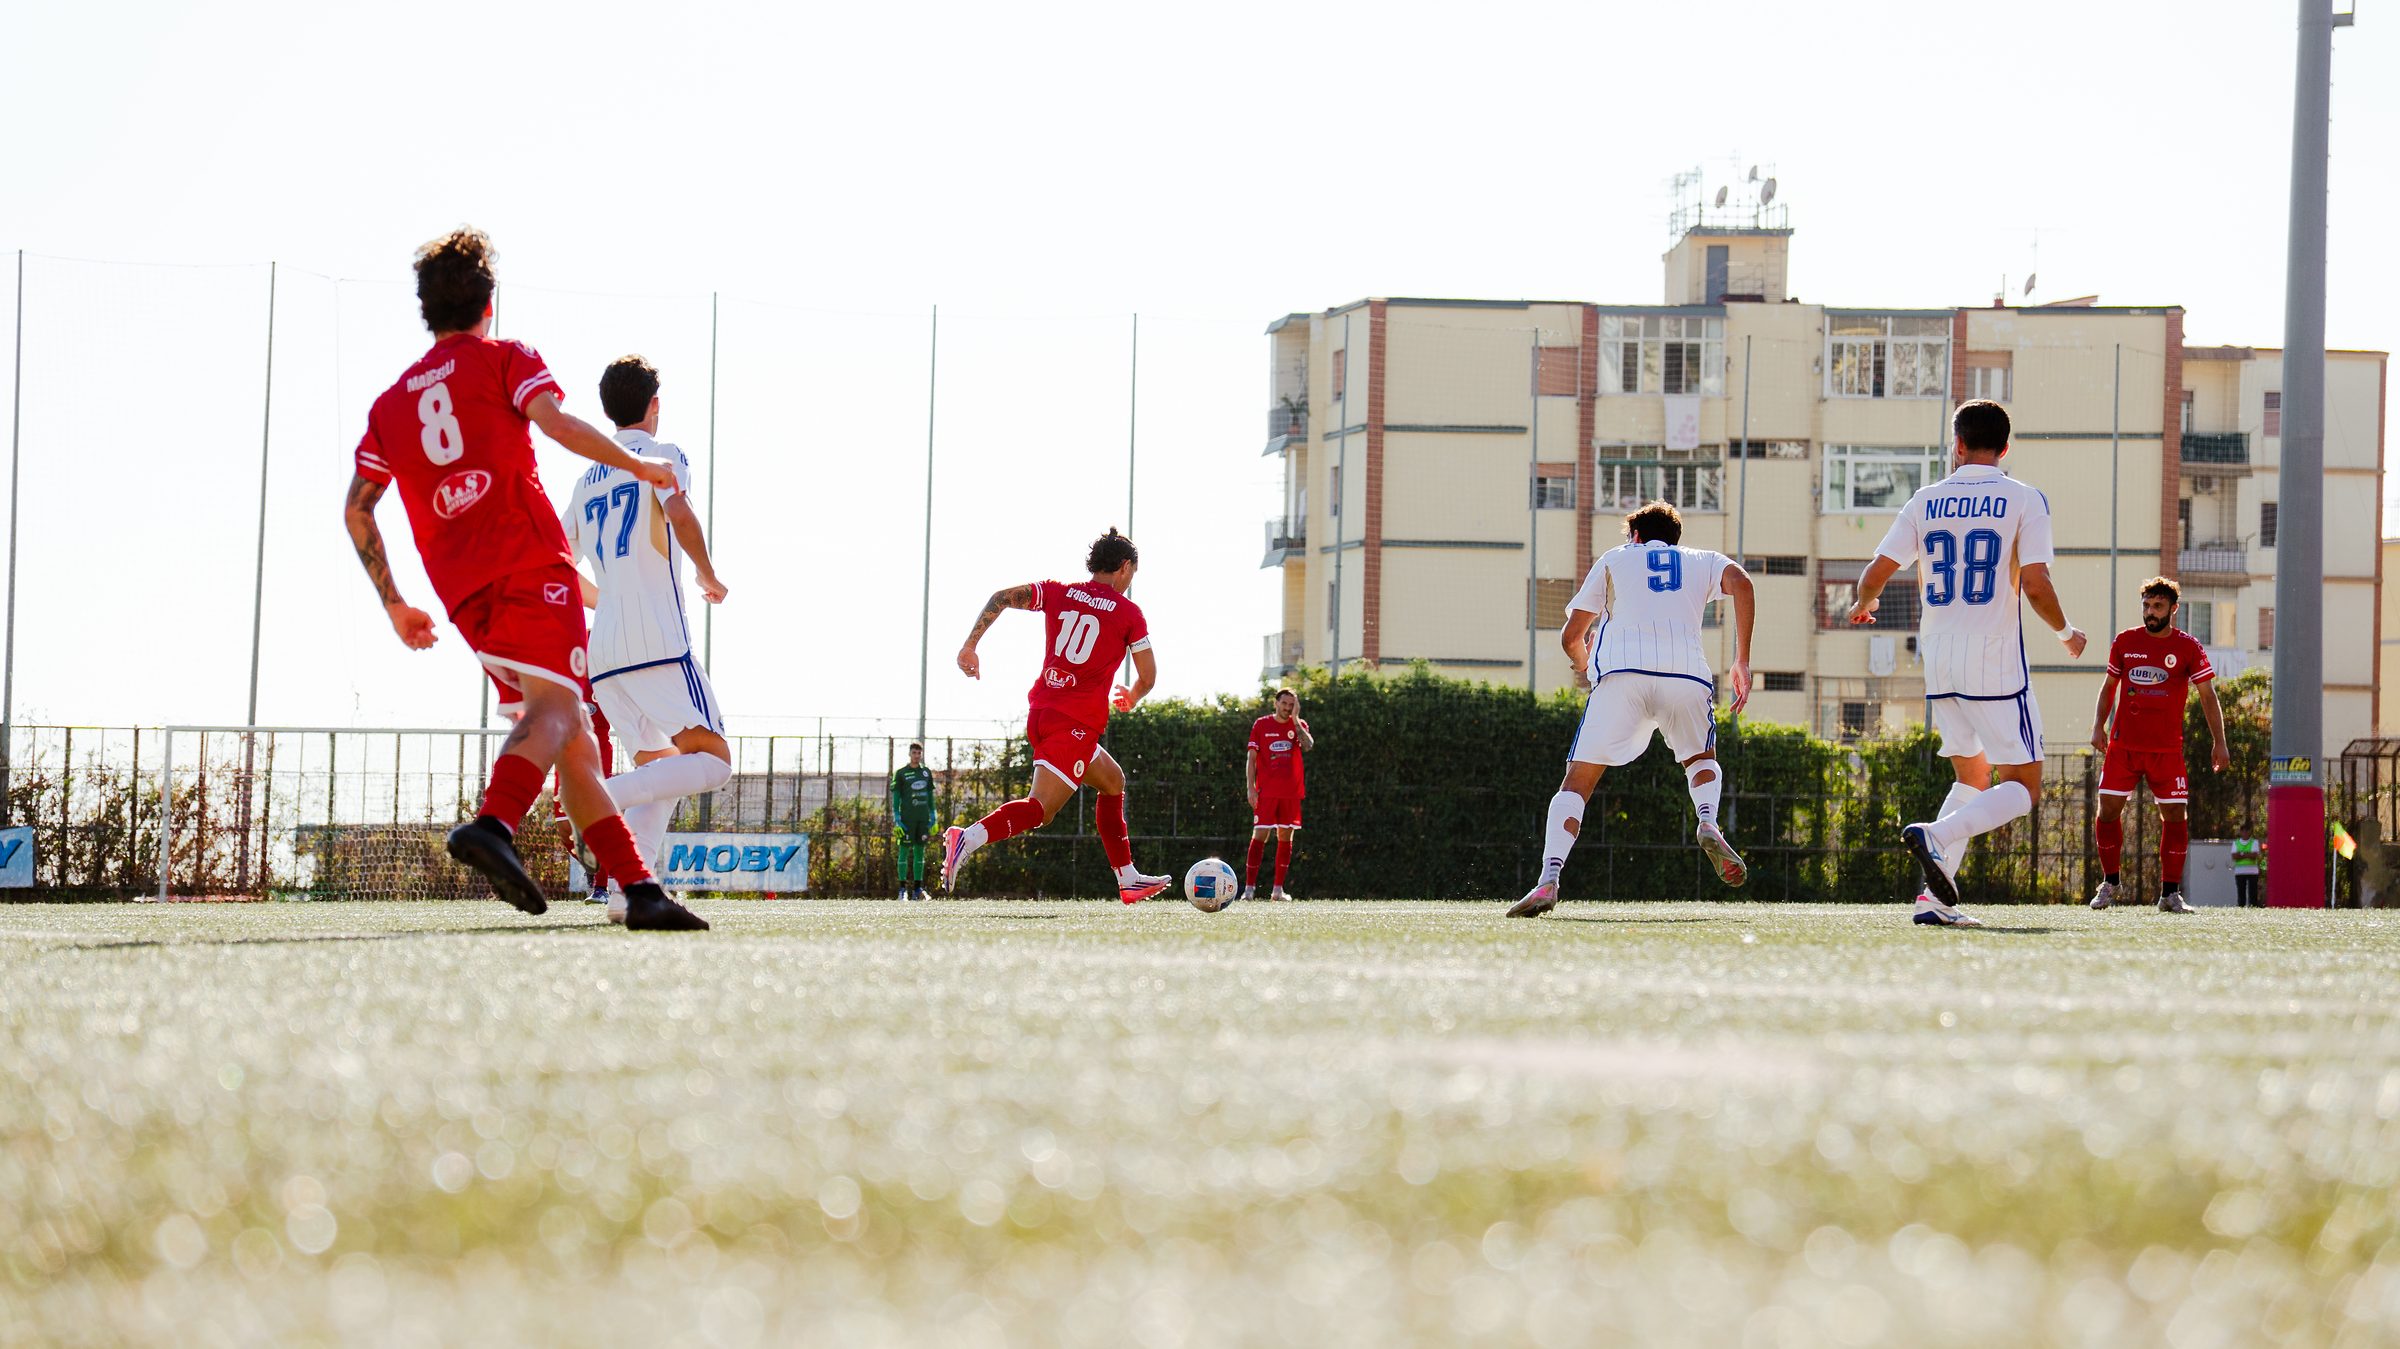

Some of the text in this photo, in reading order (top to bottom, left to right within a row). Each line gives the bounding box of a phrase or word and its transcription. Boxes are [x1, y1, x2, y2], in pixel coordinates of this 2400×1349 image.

[417, 381, 464, 466] 8
[584, 480, 640, 574] 77
[1925, 496, 2008, 520] NICOLAO
[1646, 549, 1683, 593] 9
[1923, 528, 2003, 607] 38
[1055, 610, 1100, 665] 10
[2175, 776, 2186, 790] 14
[668, 844, 801, 873] MOBY
